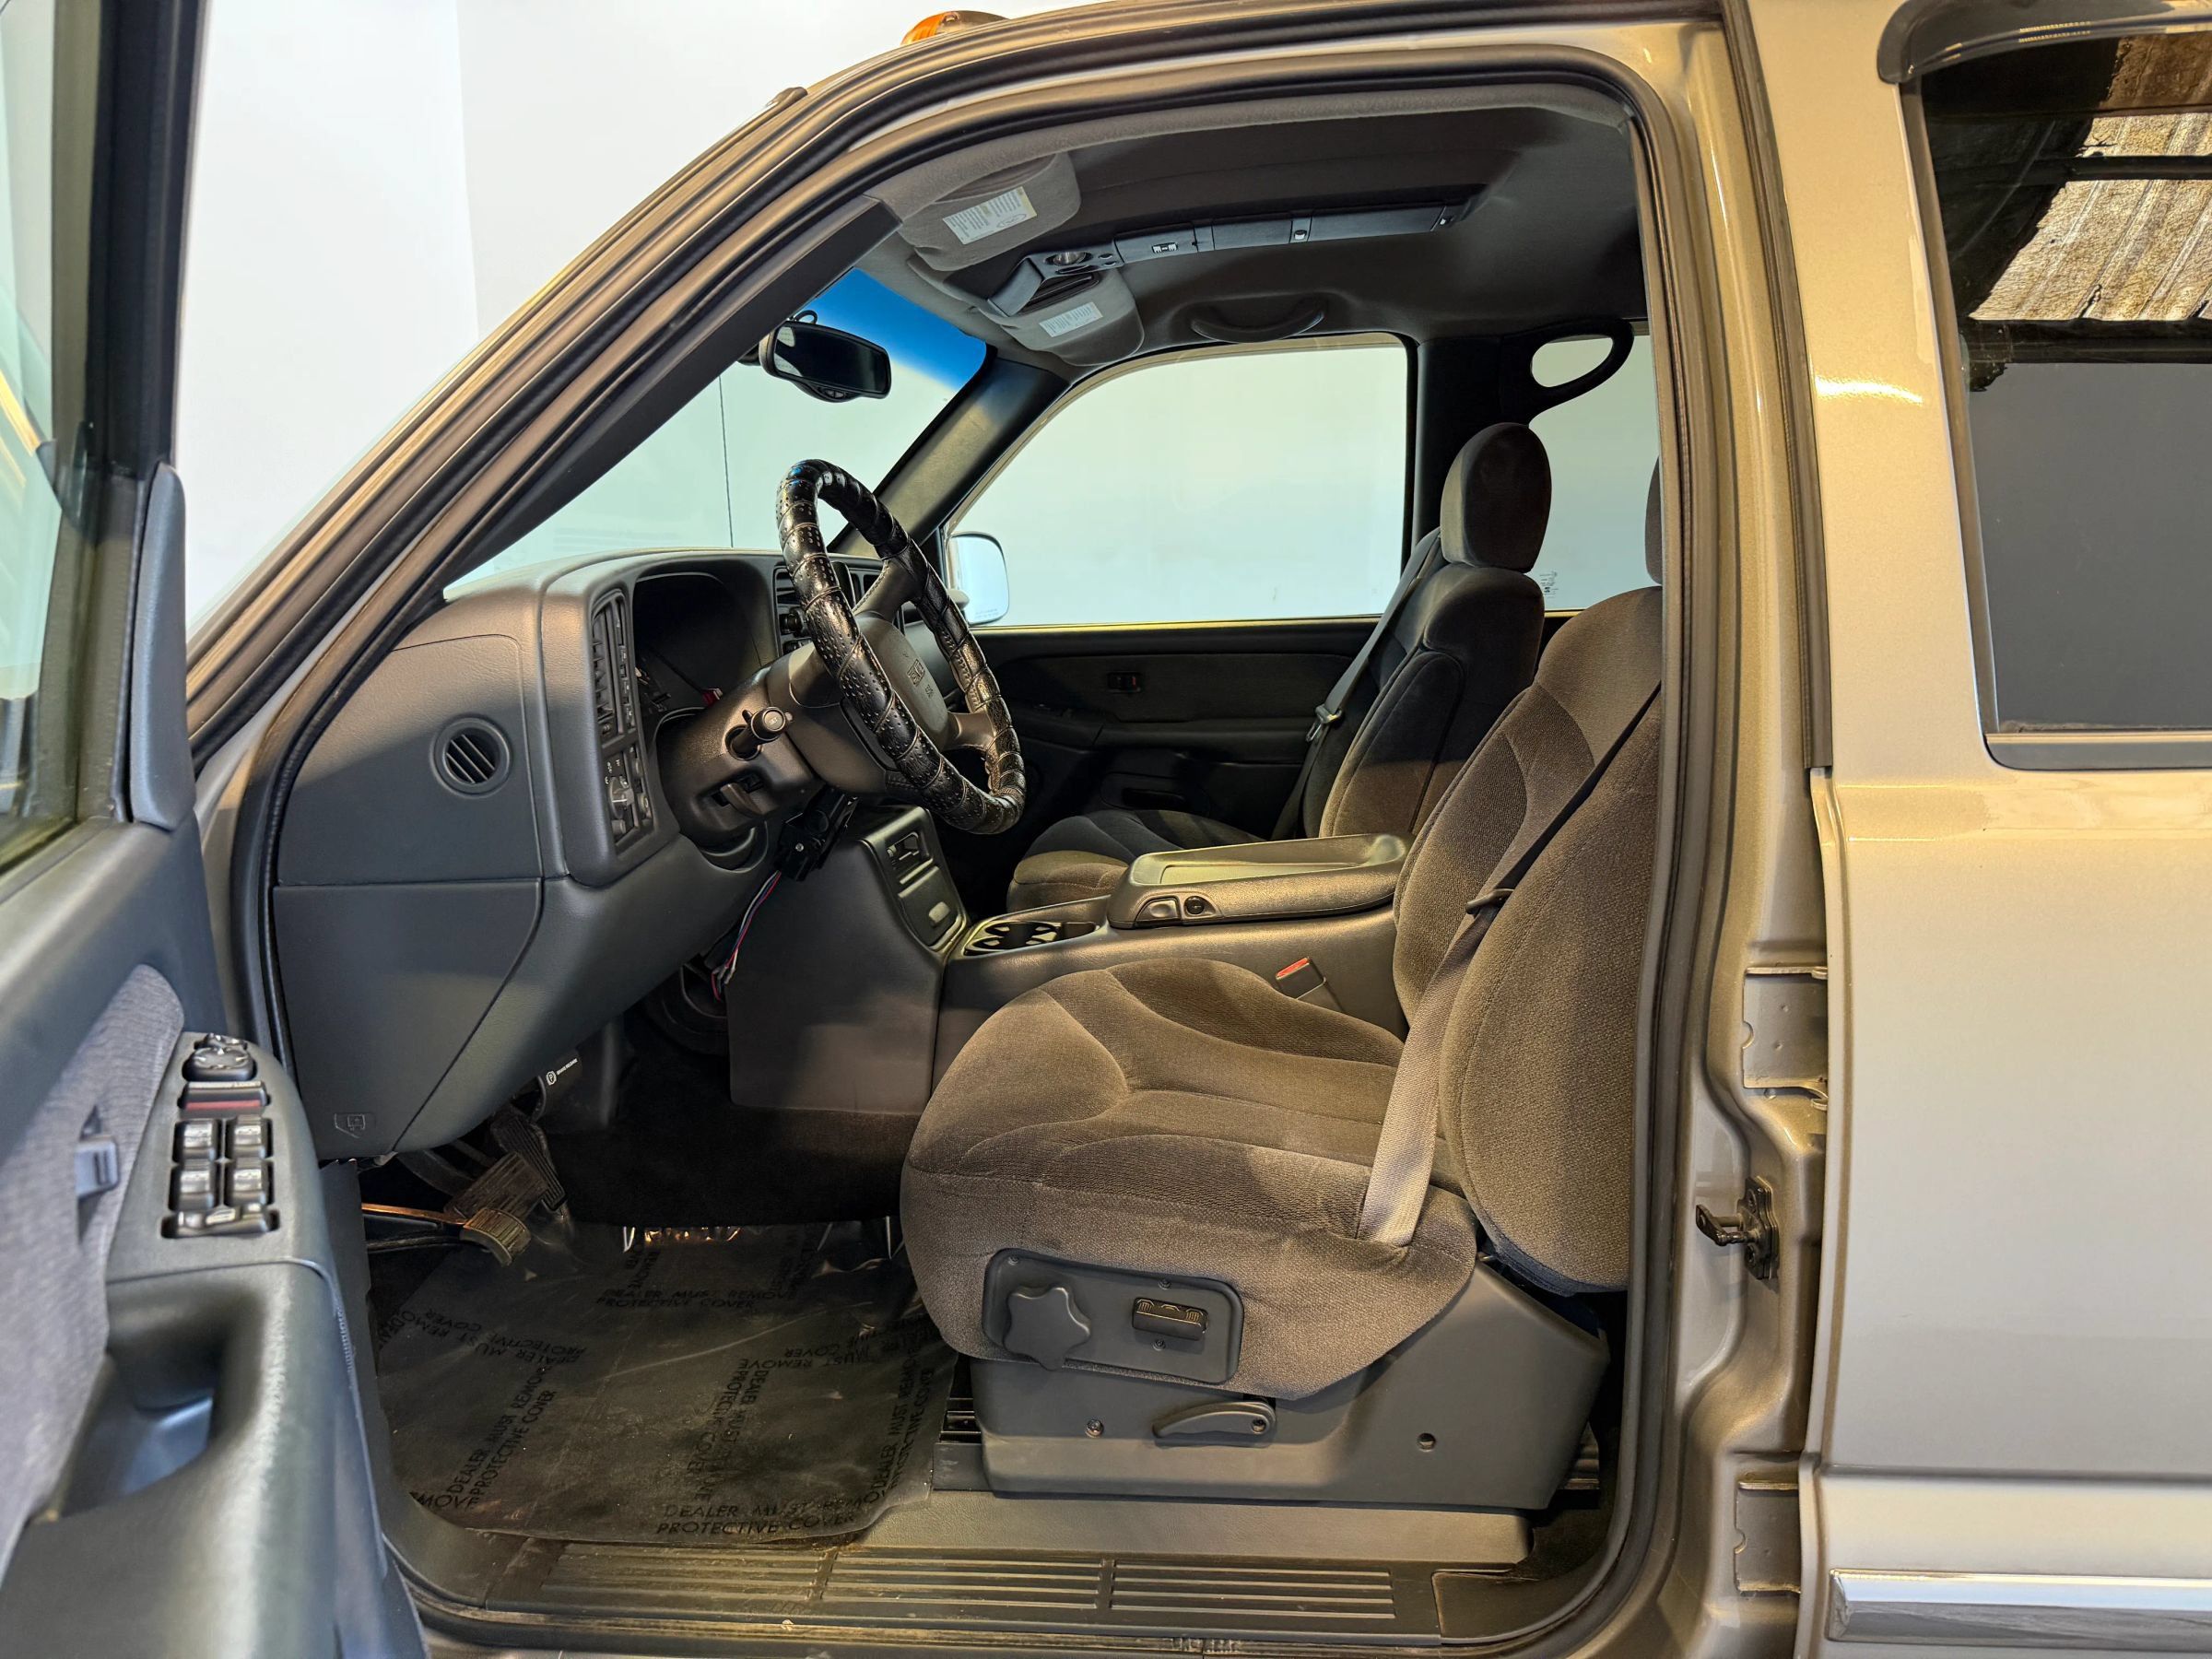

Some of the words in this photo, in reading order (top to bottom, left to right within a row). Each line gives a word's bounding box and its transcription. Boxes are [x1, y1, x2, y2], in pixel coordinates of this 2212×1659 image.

[738, 1358, 812, 1369] REMOVE
[470, 1427, 529, 1496] PROTECTIVE
[522, 1390, 557, 1424] COVER
[446, 1449, 488, 1494] DEALER
[664, 1504, 739, 1519] DEALER
[656, 1521, 780, 1536] PROTECTIVE
